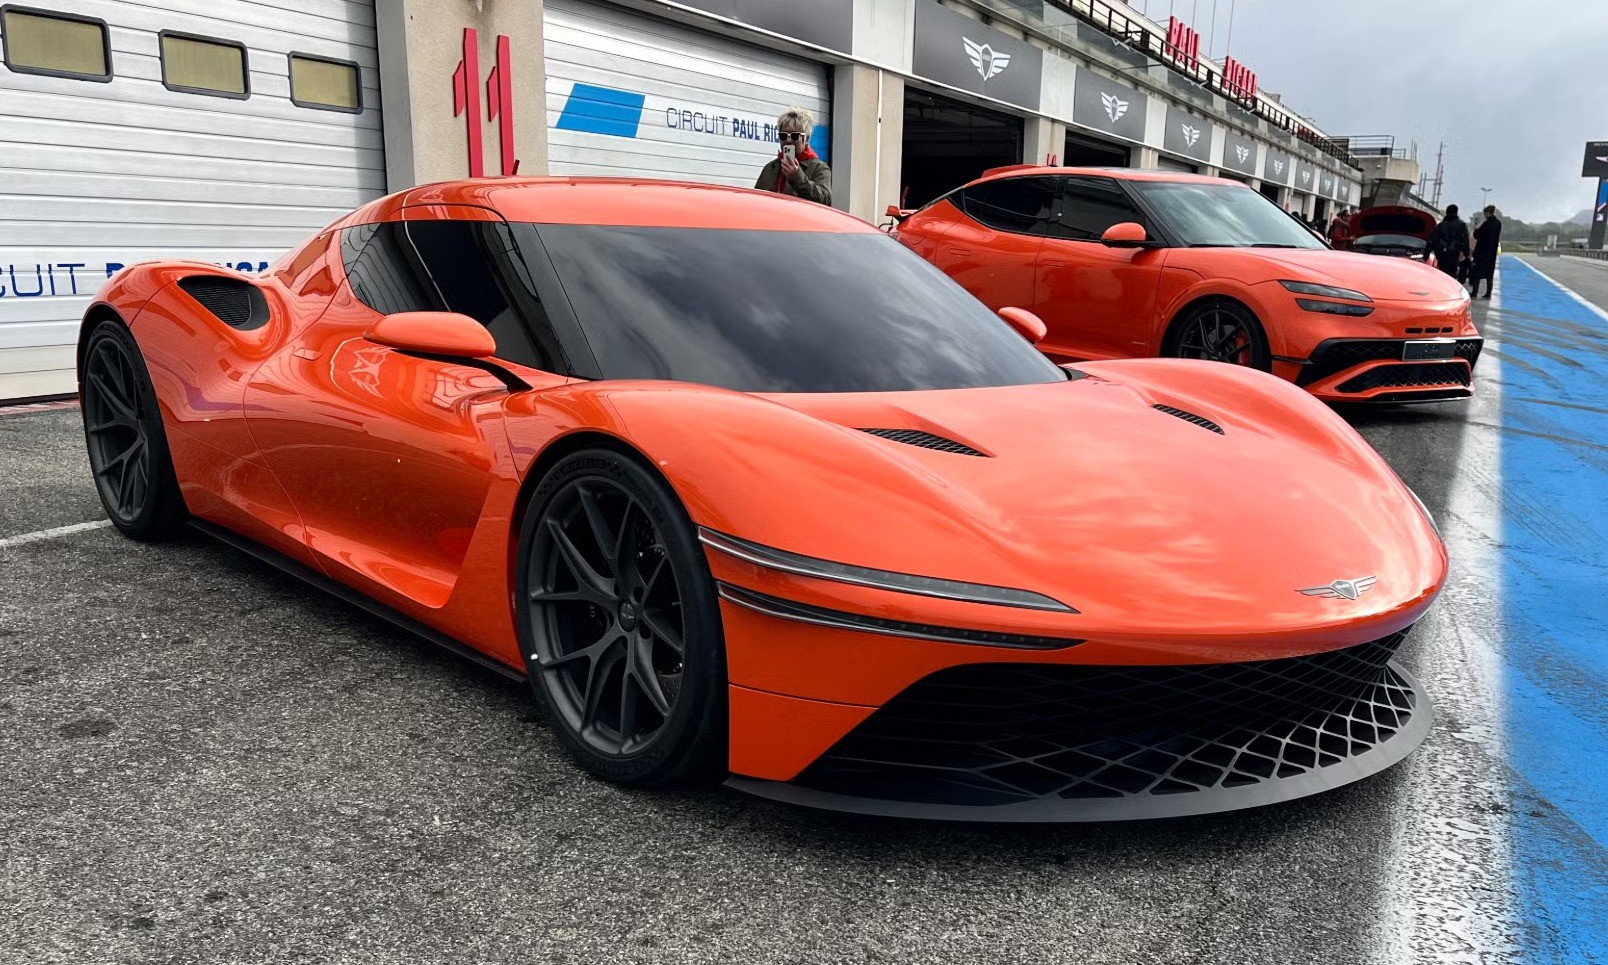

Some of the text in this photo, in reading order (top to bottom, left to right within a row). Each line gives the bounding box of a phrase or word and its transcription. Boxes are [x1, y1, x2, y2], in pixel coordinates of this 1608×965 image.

[453, 28, 515, 178] 11
[666, 107, 780, 143] CIRCUIT PAUL RIC
[0, 263, 85, 297] UIT
